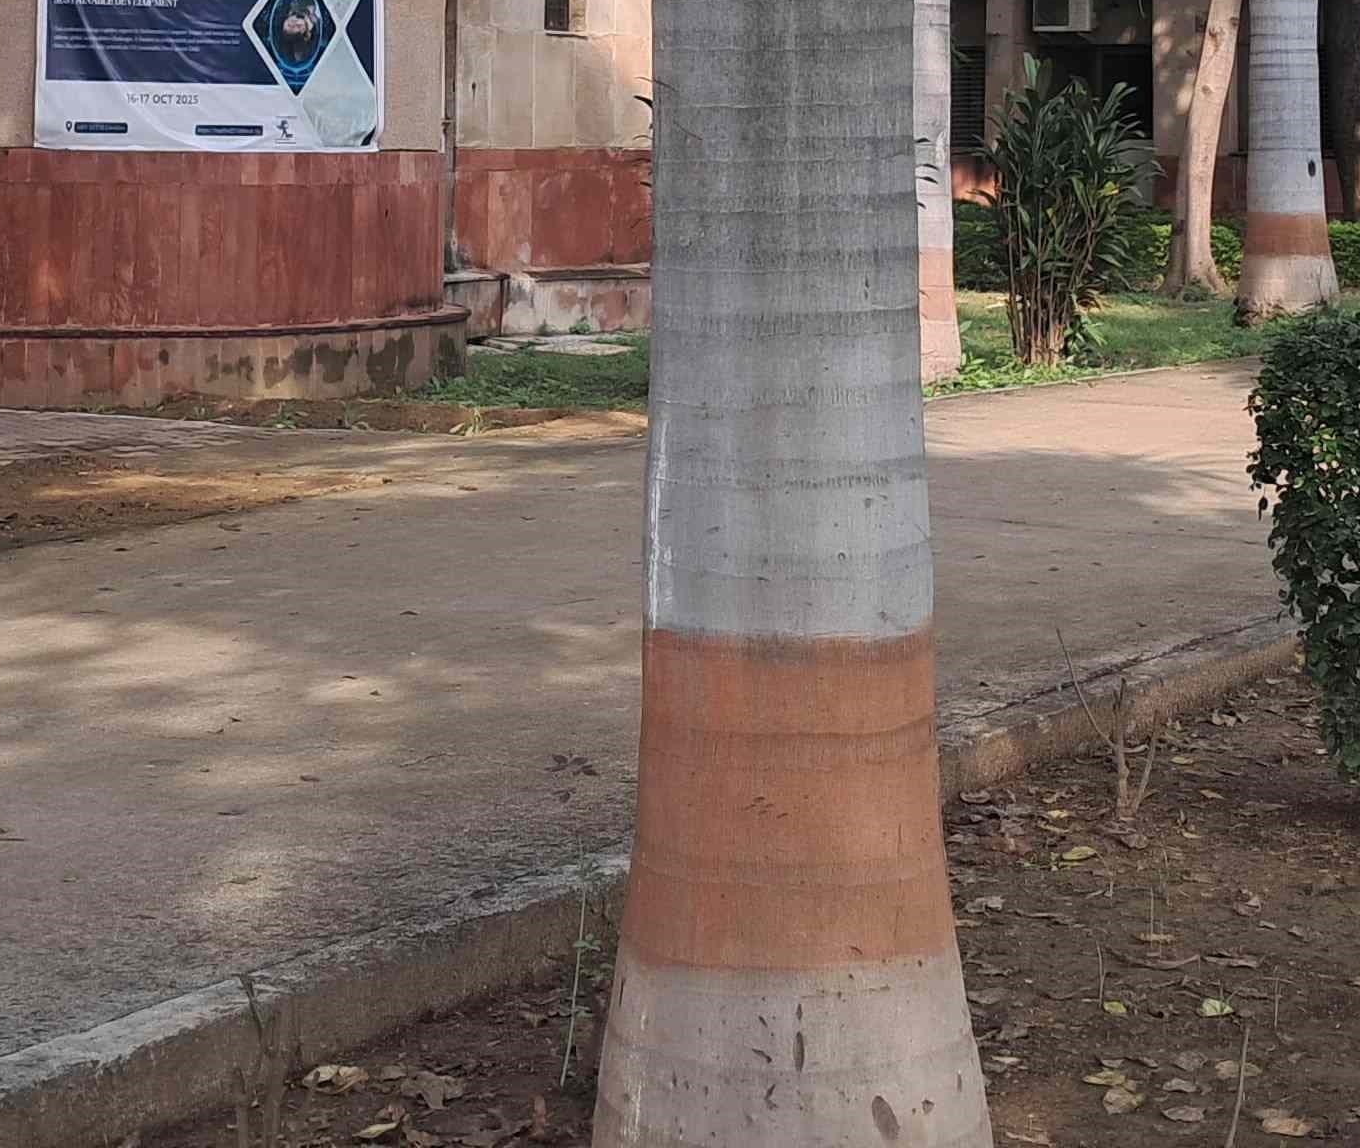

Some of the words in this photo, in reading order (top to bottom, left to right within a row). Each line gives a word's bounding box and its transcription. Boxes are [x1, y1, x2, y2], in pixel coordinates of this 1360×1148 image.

[127, 93, 150, 104] 16-17
[152, 94, 173, 105] OCT
[175, 94, 199, 105] 2025
